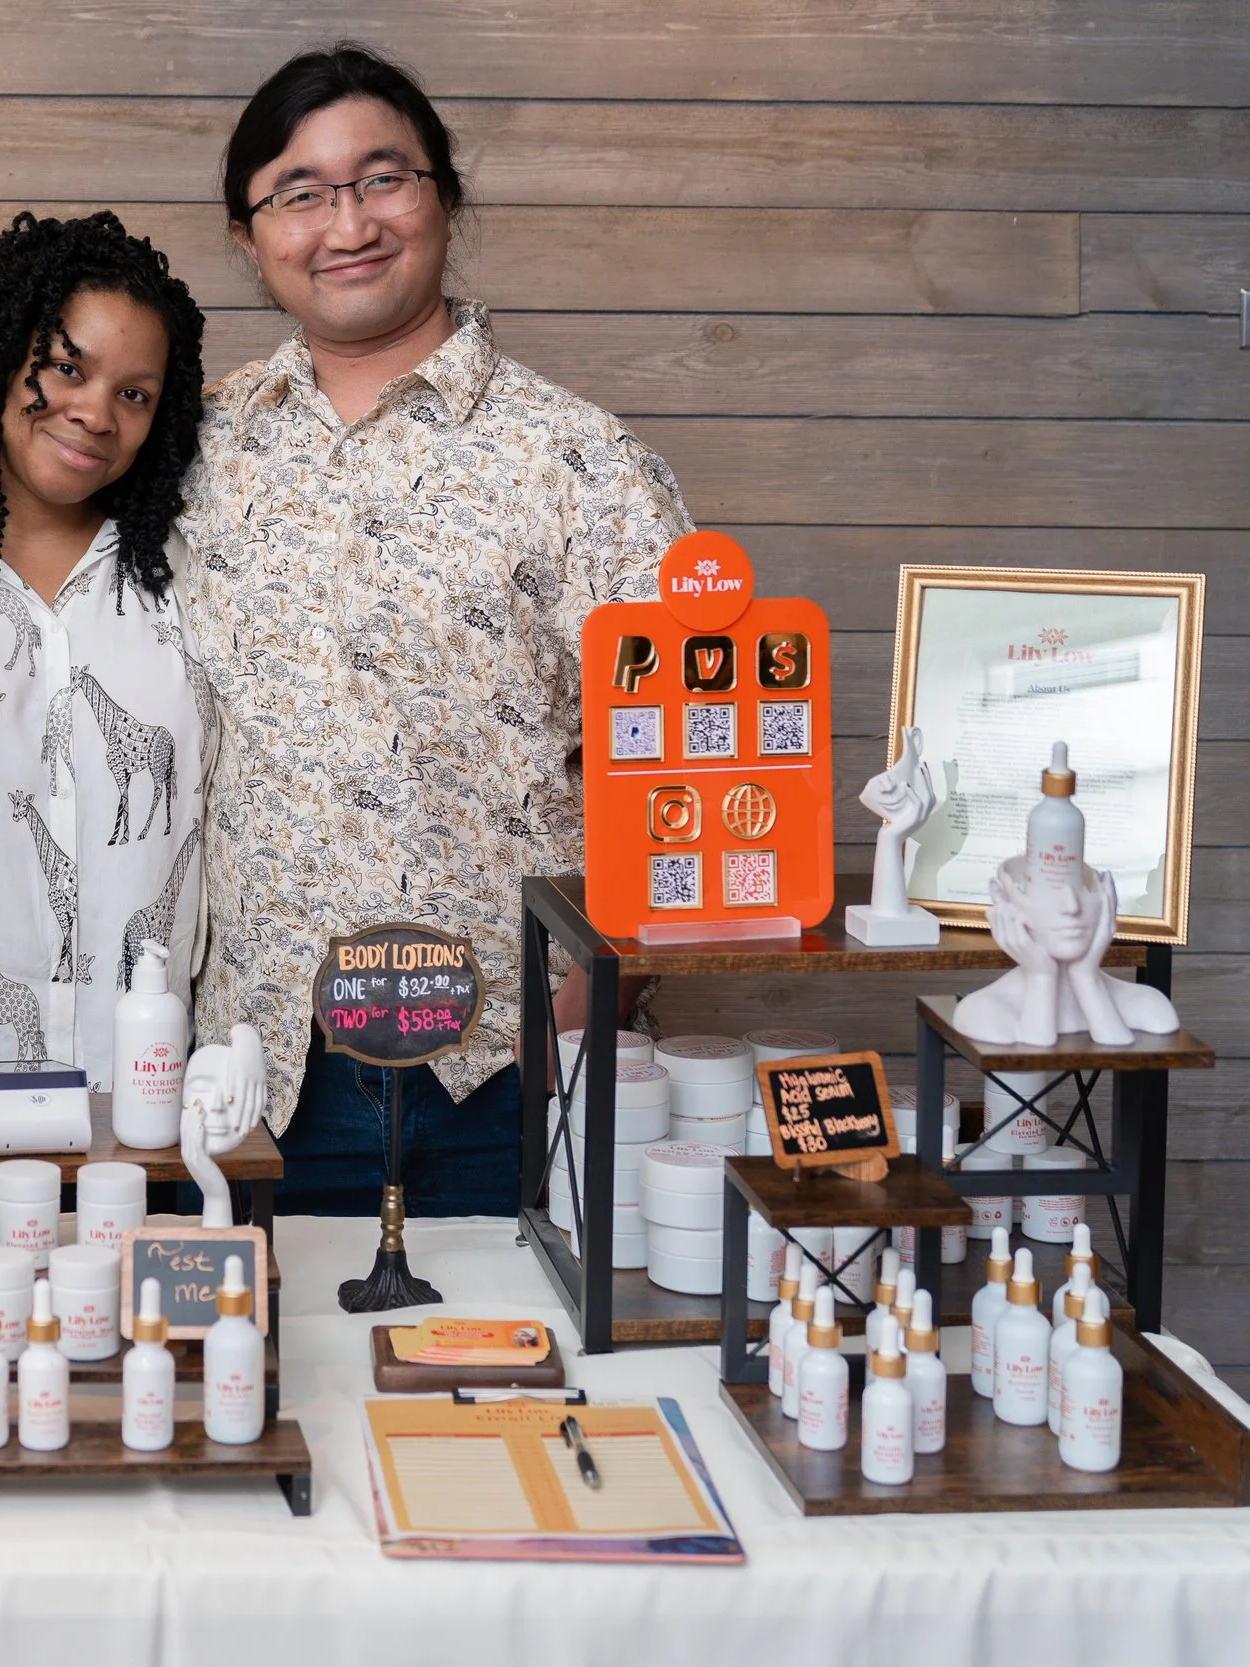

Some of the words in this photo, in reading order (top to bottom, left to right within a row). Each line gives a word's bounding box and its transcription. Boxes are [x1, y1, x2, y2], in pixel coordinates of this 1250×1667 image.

[672, 577, 704, 597] Lily
[707, 577, 743, 592] Low
[1008, 644, 1048, 666] Lily
[1051, 647, 1095, 663] Low
[1027, 685, 1057, 693] About
[338, 942, 388, 971] BODY
[392, 944, 465, 970] LOTIONS
[334, 978, 366, 1001] ONE
[371, 977, 387, 988] for
[332, 1009, 367, 1029] TWO
[372, 1007, 388, 1018] for
[134, 1060, 159, 1076] Lily
[162, 1061, 182, 1072] Low
[1017, 1119, 1032, 1129] Lily
[12, 1231, 30, 1241] Lily
[33, 1229, 51, 1238] Low
[89, 1230, 107, 1243] Lily
[109, 1232, 122, 1240] Lo
[174, 1283, 216, 1303] me
